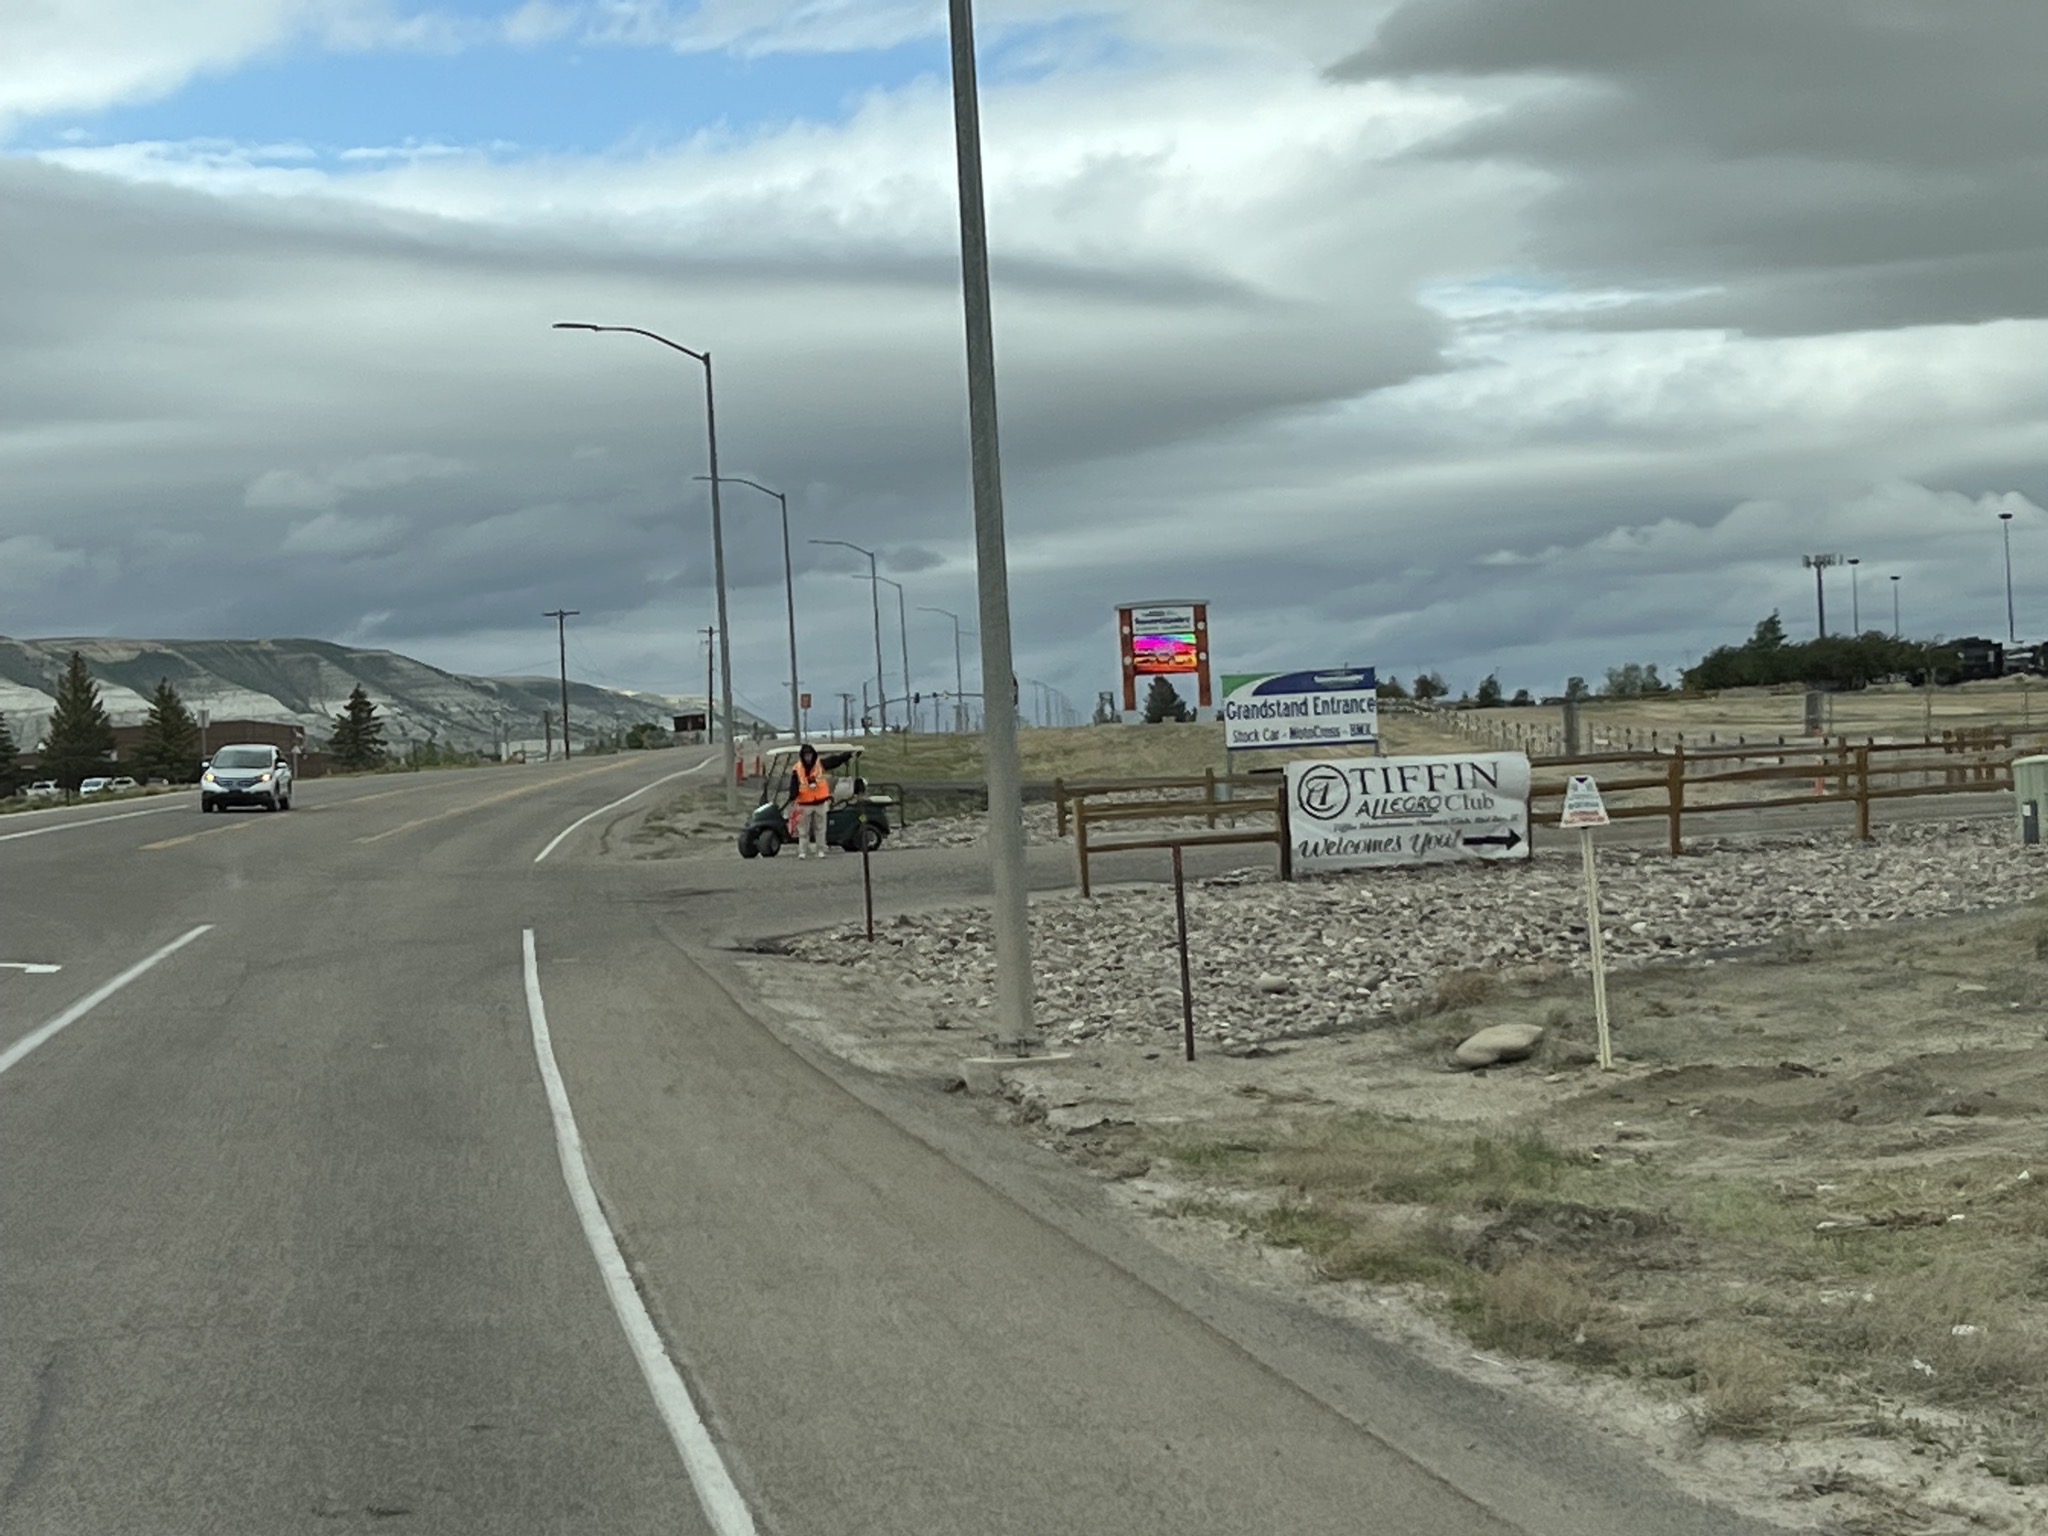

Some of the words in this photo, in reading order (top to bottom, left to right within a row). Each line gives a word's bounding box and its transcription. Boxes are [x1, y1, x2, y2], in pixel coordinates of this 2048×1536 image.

[1226, 696, 1308, 720] Grandstand
[1313, 695, 1375, 716] Entrance
[1262, 727, 1280, 741] Car
[1348, 761, 1499, 796] TIFFIN
[1355, 795, 1441, 819] ALLEGRO
[1444, 792, 1496, 812] Club
